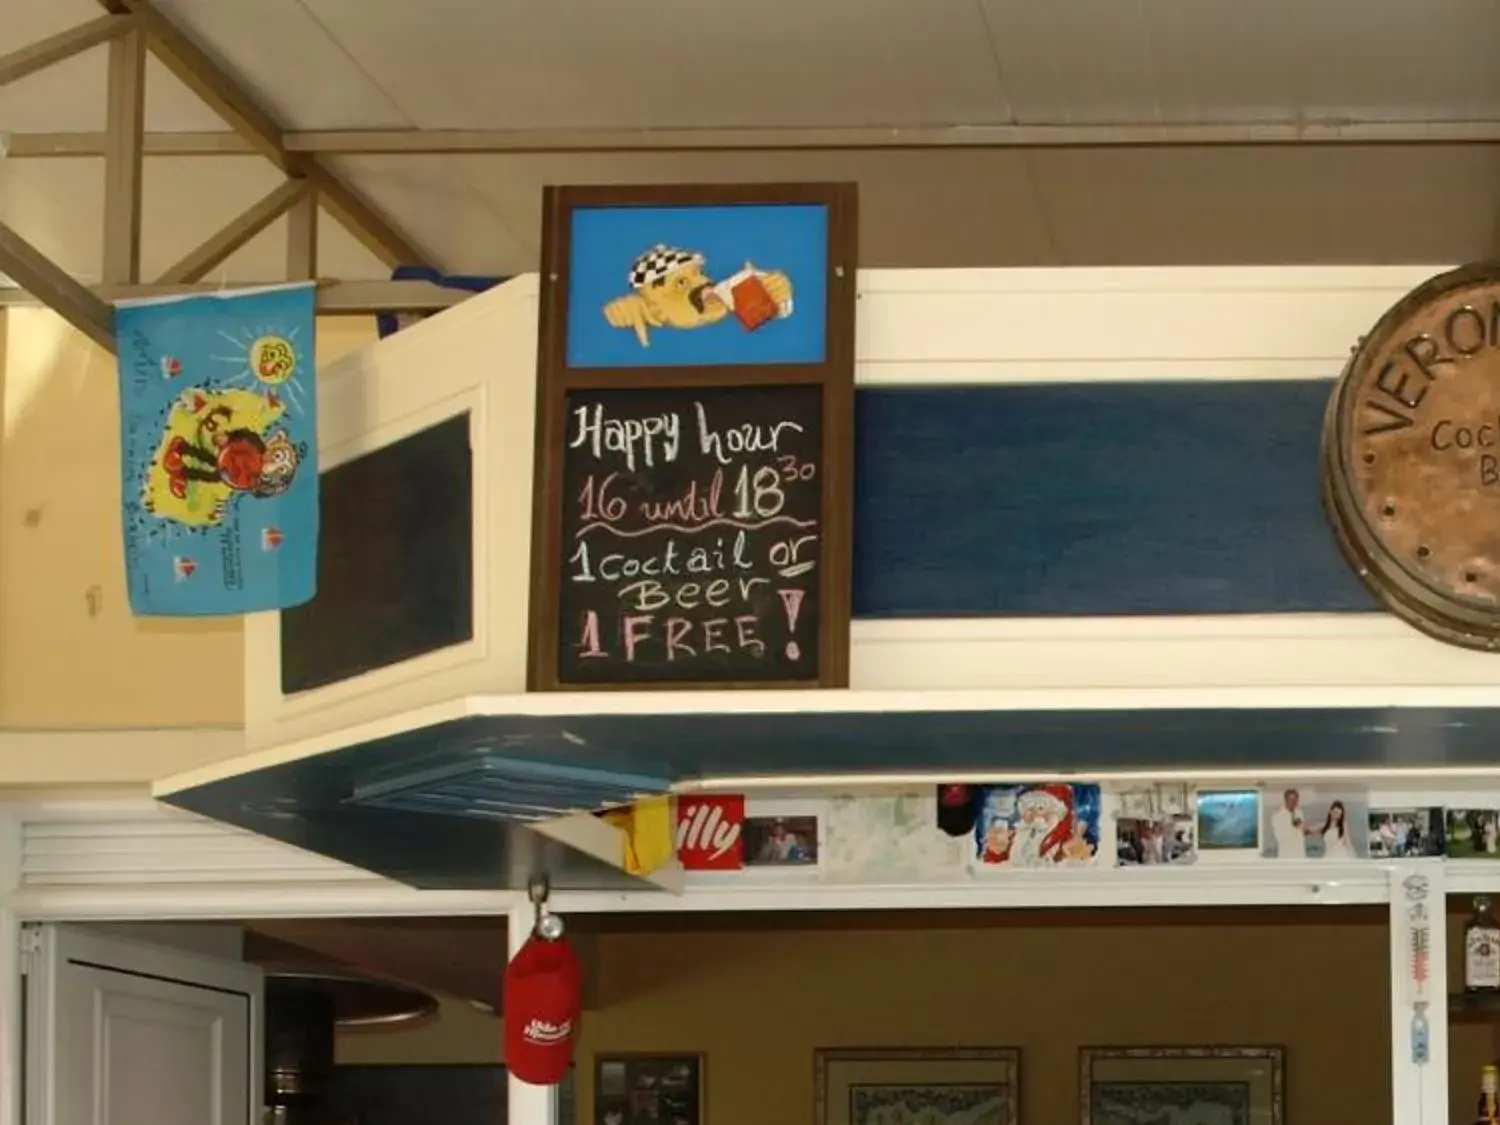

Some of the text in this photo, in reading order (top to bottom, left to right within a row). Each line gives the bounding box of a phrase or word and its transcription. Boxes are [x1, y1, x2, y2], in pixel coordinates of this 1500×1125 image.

[569, 402, 803, 472] Happy hour
[578, 471, 627, 522] 16
[640, 467, 724, 521] until
[769, 535, 817, 567] or
[618, 578, 770, 611] Beer
[579, 609, 608, 657] 1
[676, 803, 741, 861] illy
